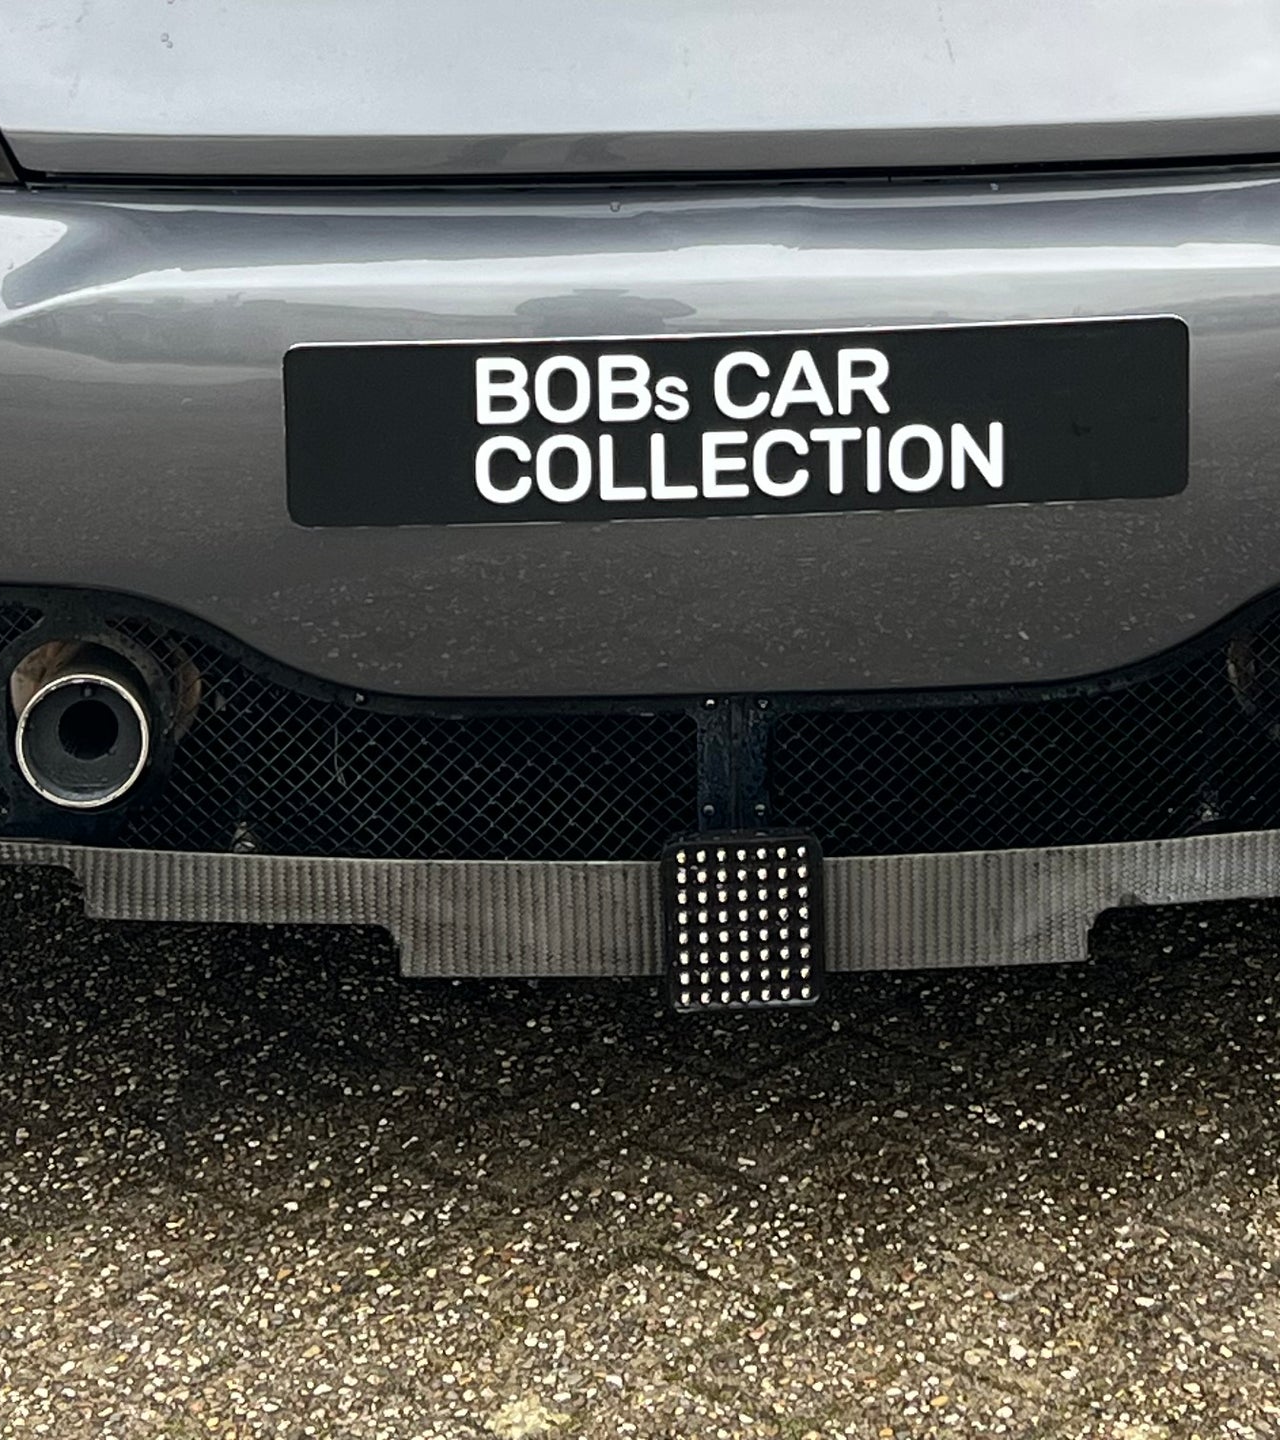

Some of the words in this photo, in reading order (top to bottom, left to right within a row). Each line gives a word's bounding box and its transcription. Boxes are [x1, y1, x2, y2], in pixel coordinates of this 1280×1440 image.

[476, 354, 690, 425] BOBs
[713, 348, 891, 420] CAR
[474, 421, 1005, 504] COLLECTION
